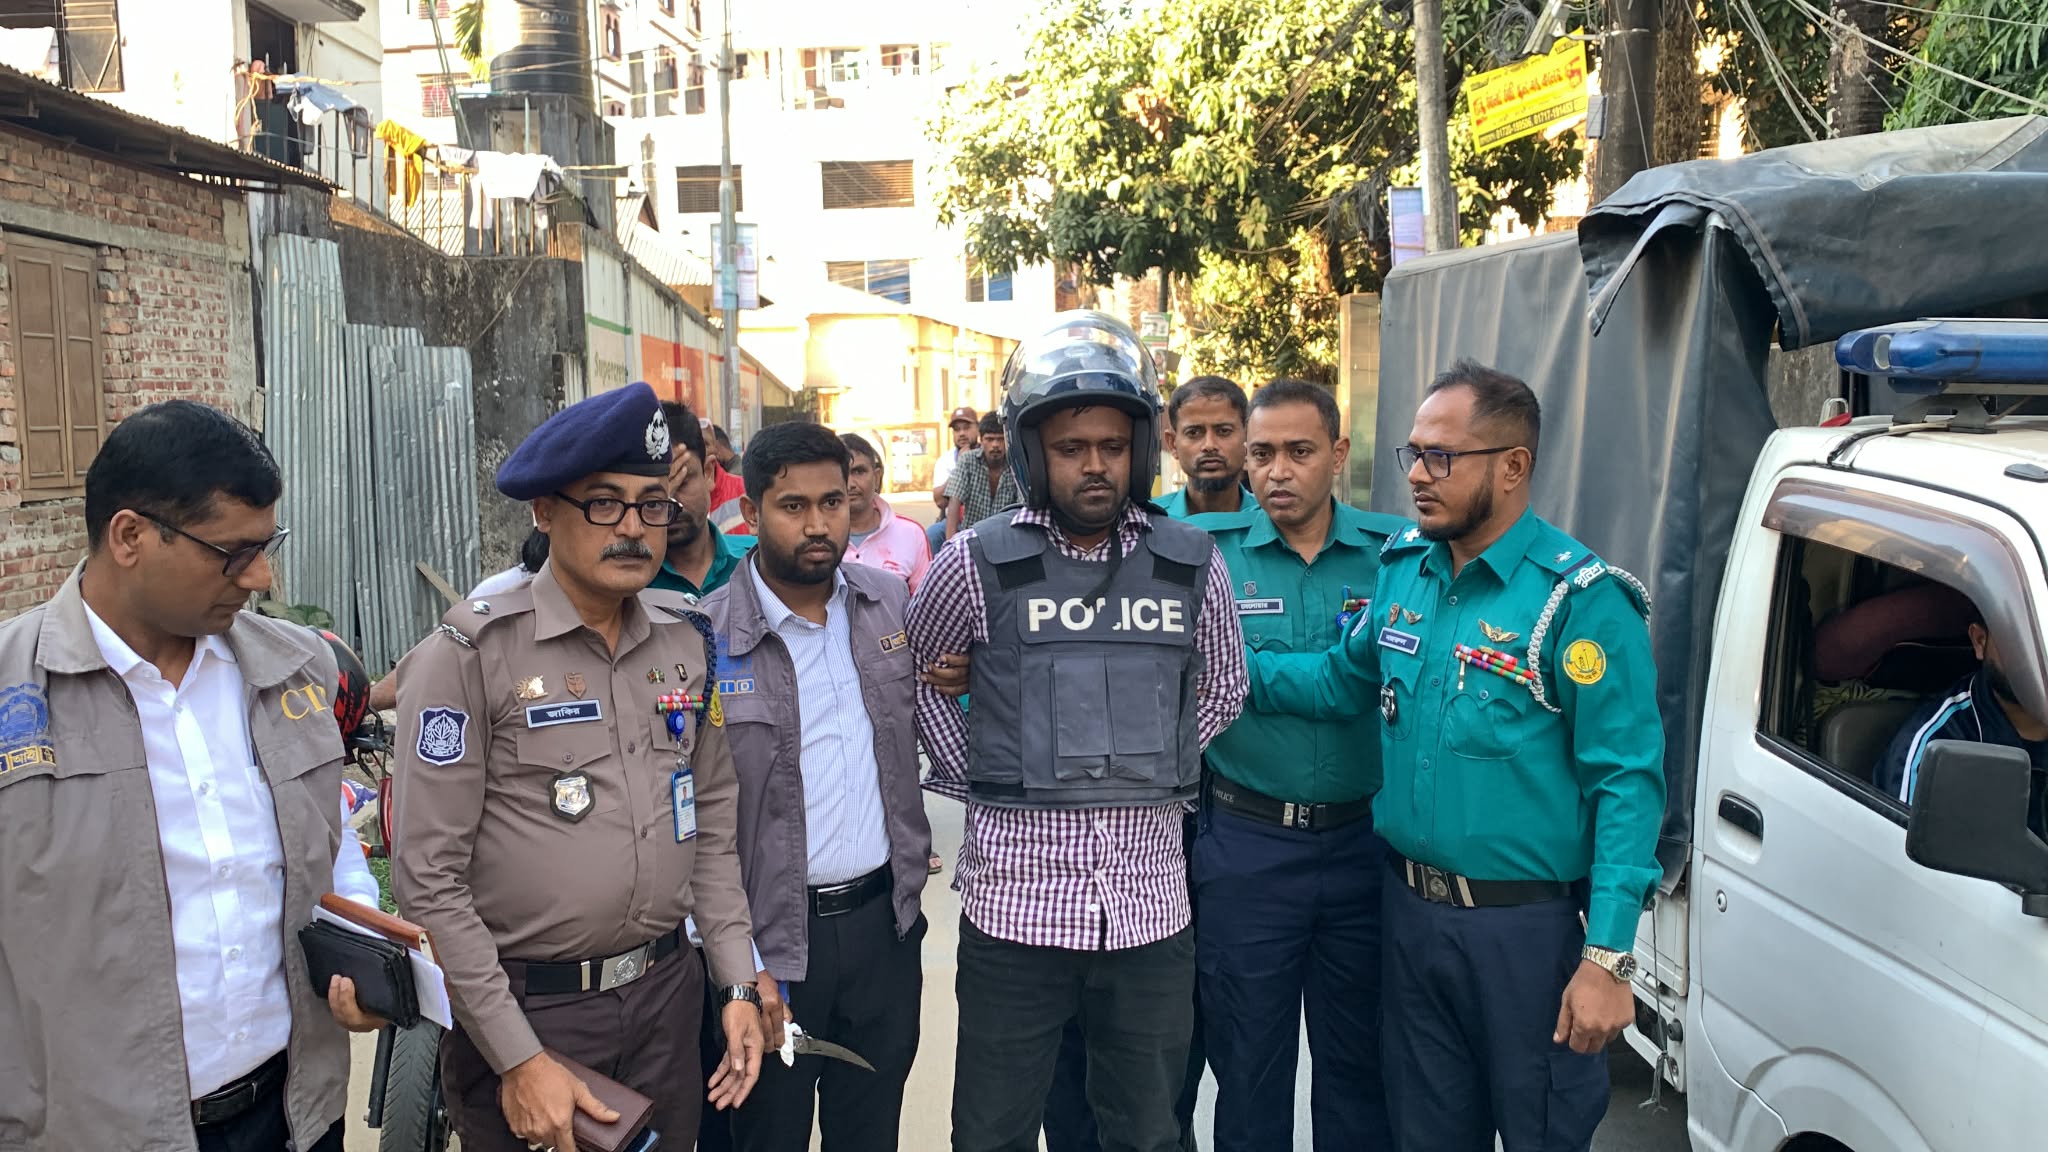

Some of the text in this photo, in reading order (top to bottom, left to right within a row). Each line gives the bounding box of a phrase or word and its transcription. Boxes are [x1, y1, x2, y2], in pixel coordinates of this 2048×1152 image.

[1574, 562, 1606, 588] পুলিশ
[1028, 597, 1185, 632] POICE
[546, 706, 581, 718] জাকির
